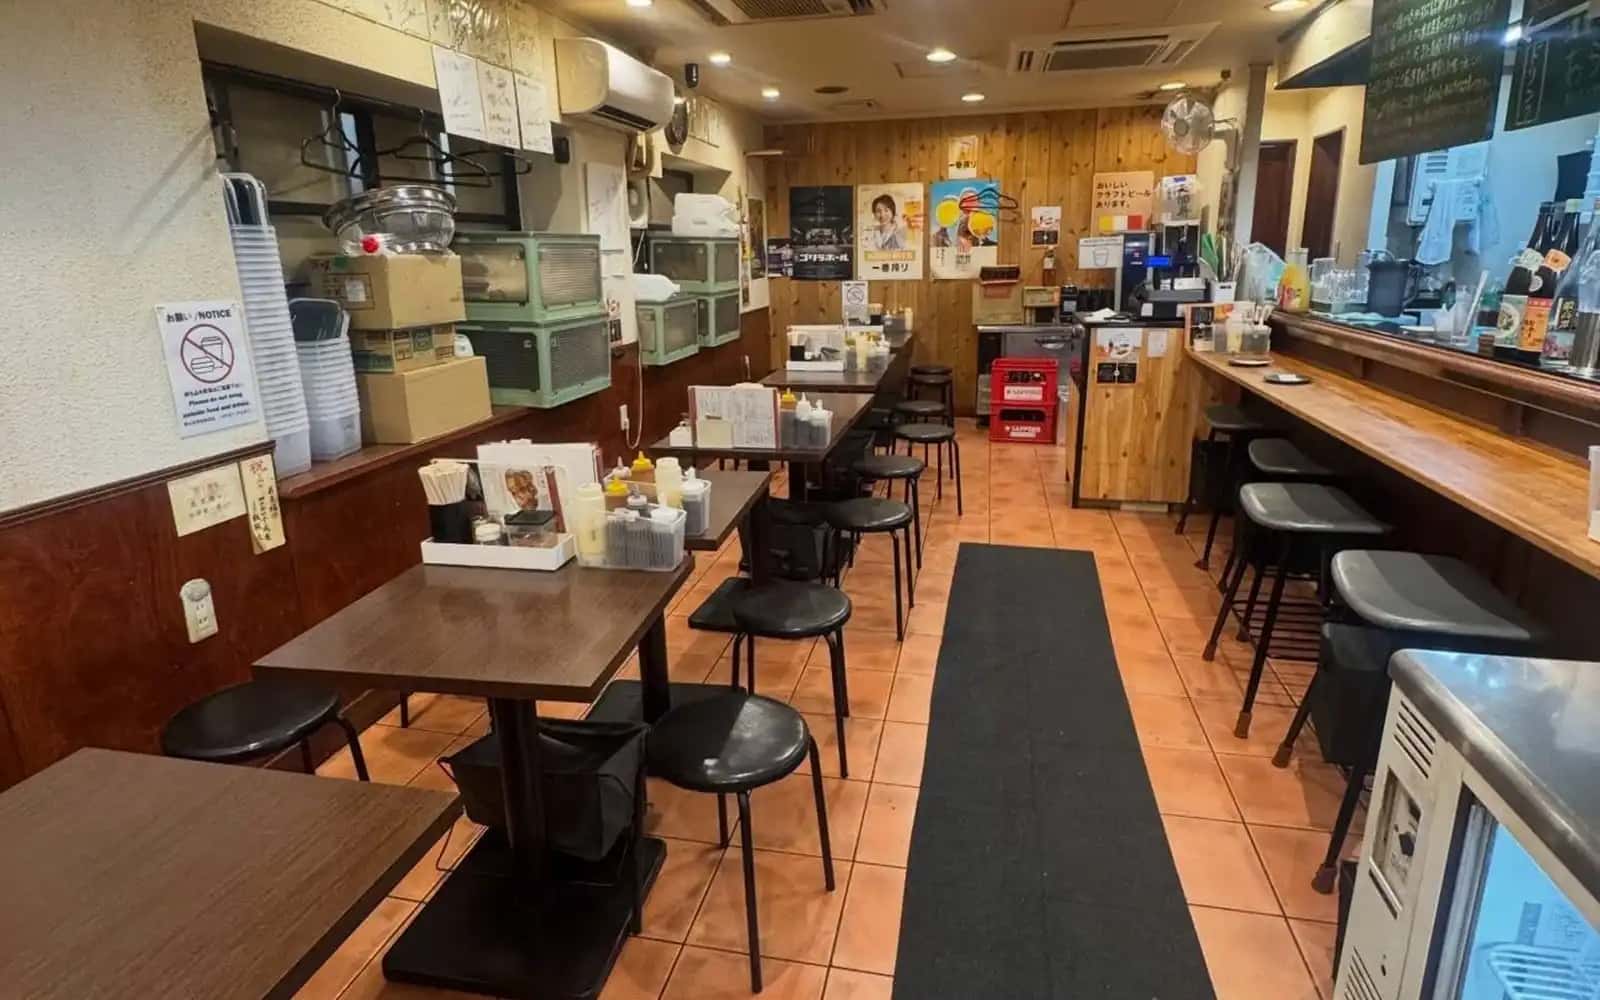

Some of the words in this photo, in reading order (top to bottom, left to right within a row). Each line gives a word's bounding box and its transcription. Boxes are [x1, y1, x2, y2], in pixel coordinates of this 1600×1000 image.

[1096, 182, 1128, 190] おいしい
[1096, 190, 1151, 199] クラフトビール
[872, 263, 909, 272] 一番搾り
